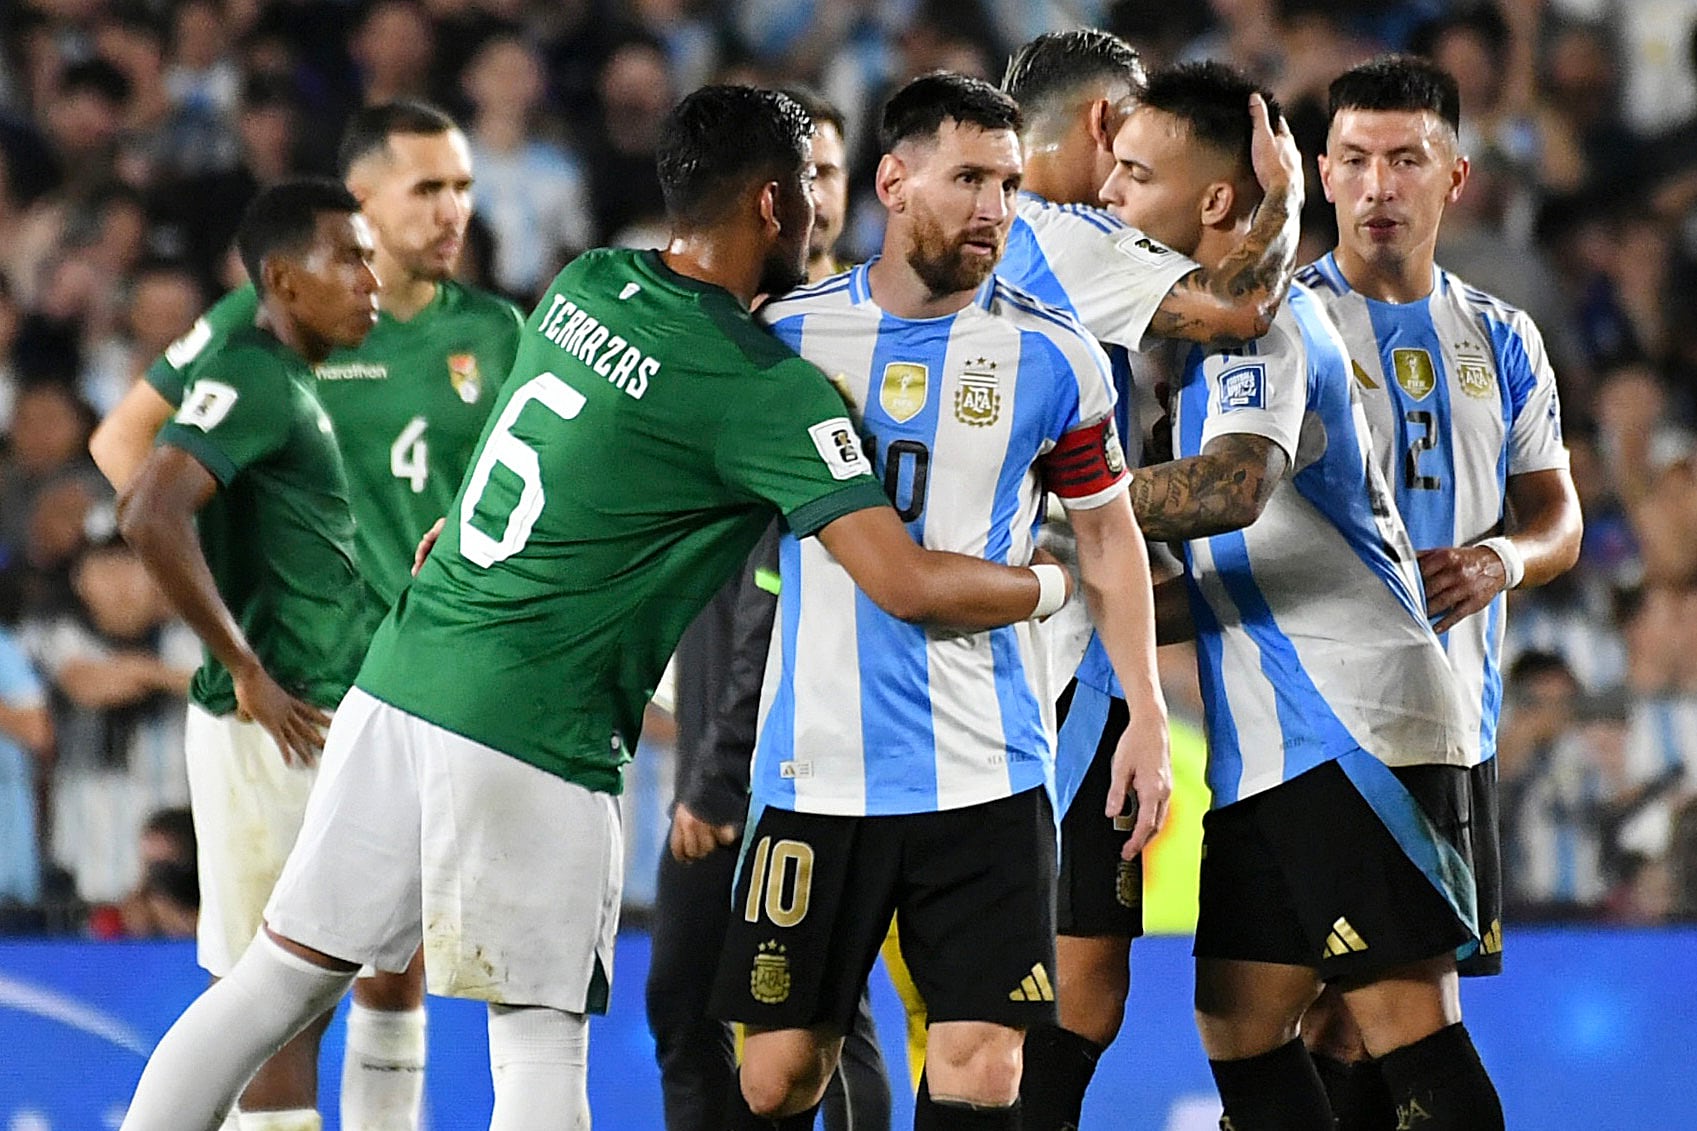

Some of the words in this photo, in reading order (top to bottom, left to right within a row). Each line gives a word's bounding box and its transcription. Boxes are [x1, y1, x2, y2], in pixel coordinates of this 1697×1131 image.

[538, 293, 661, 400] TERRAZAS
[963, 386, 992, 413] AFA
[391, 416, 428, 493] 4
[459, 371, 588, 569] 6
[1405, 411, 1441, 490] 2
[744, 836, 814, 927] 10
